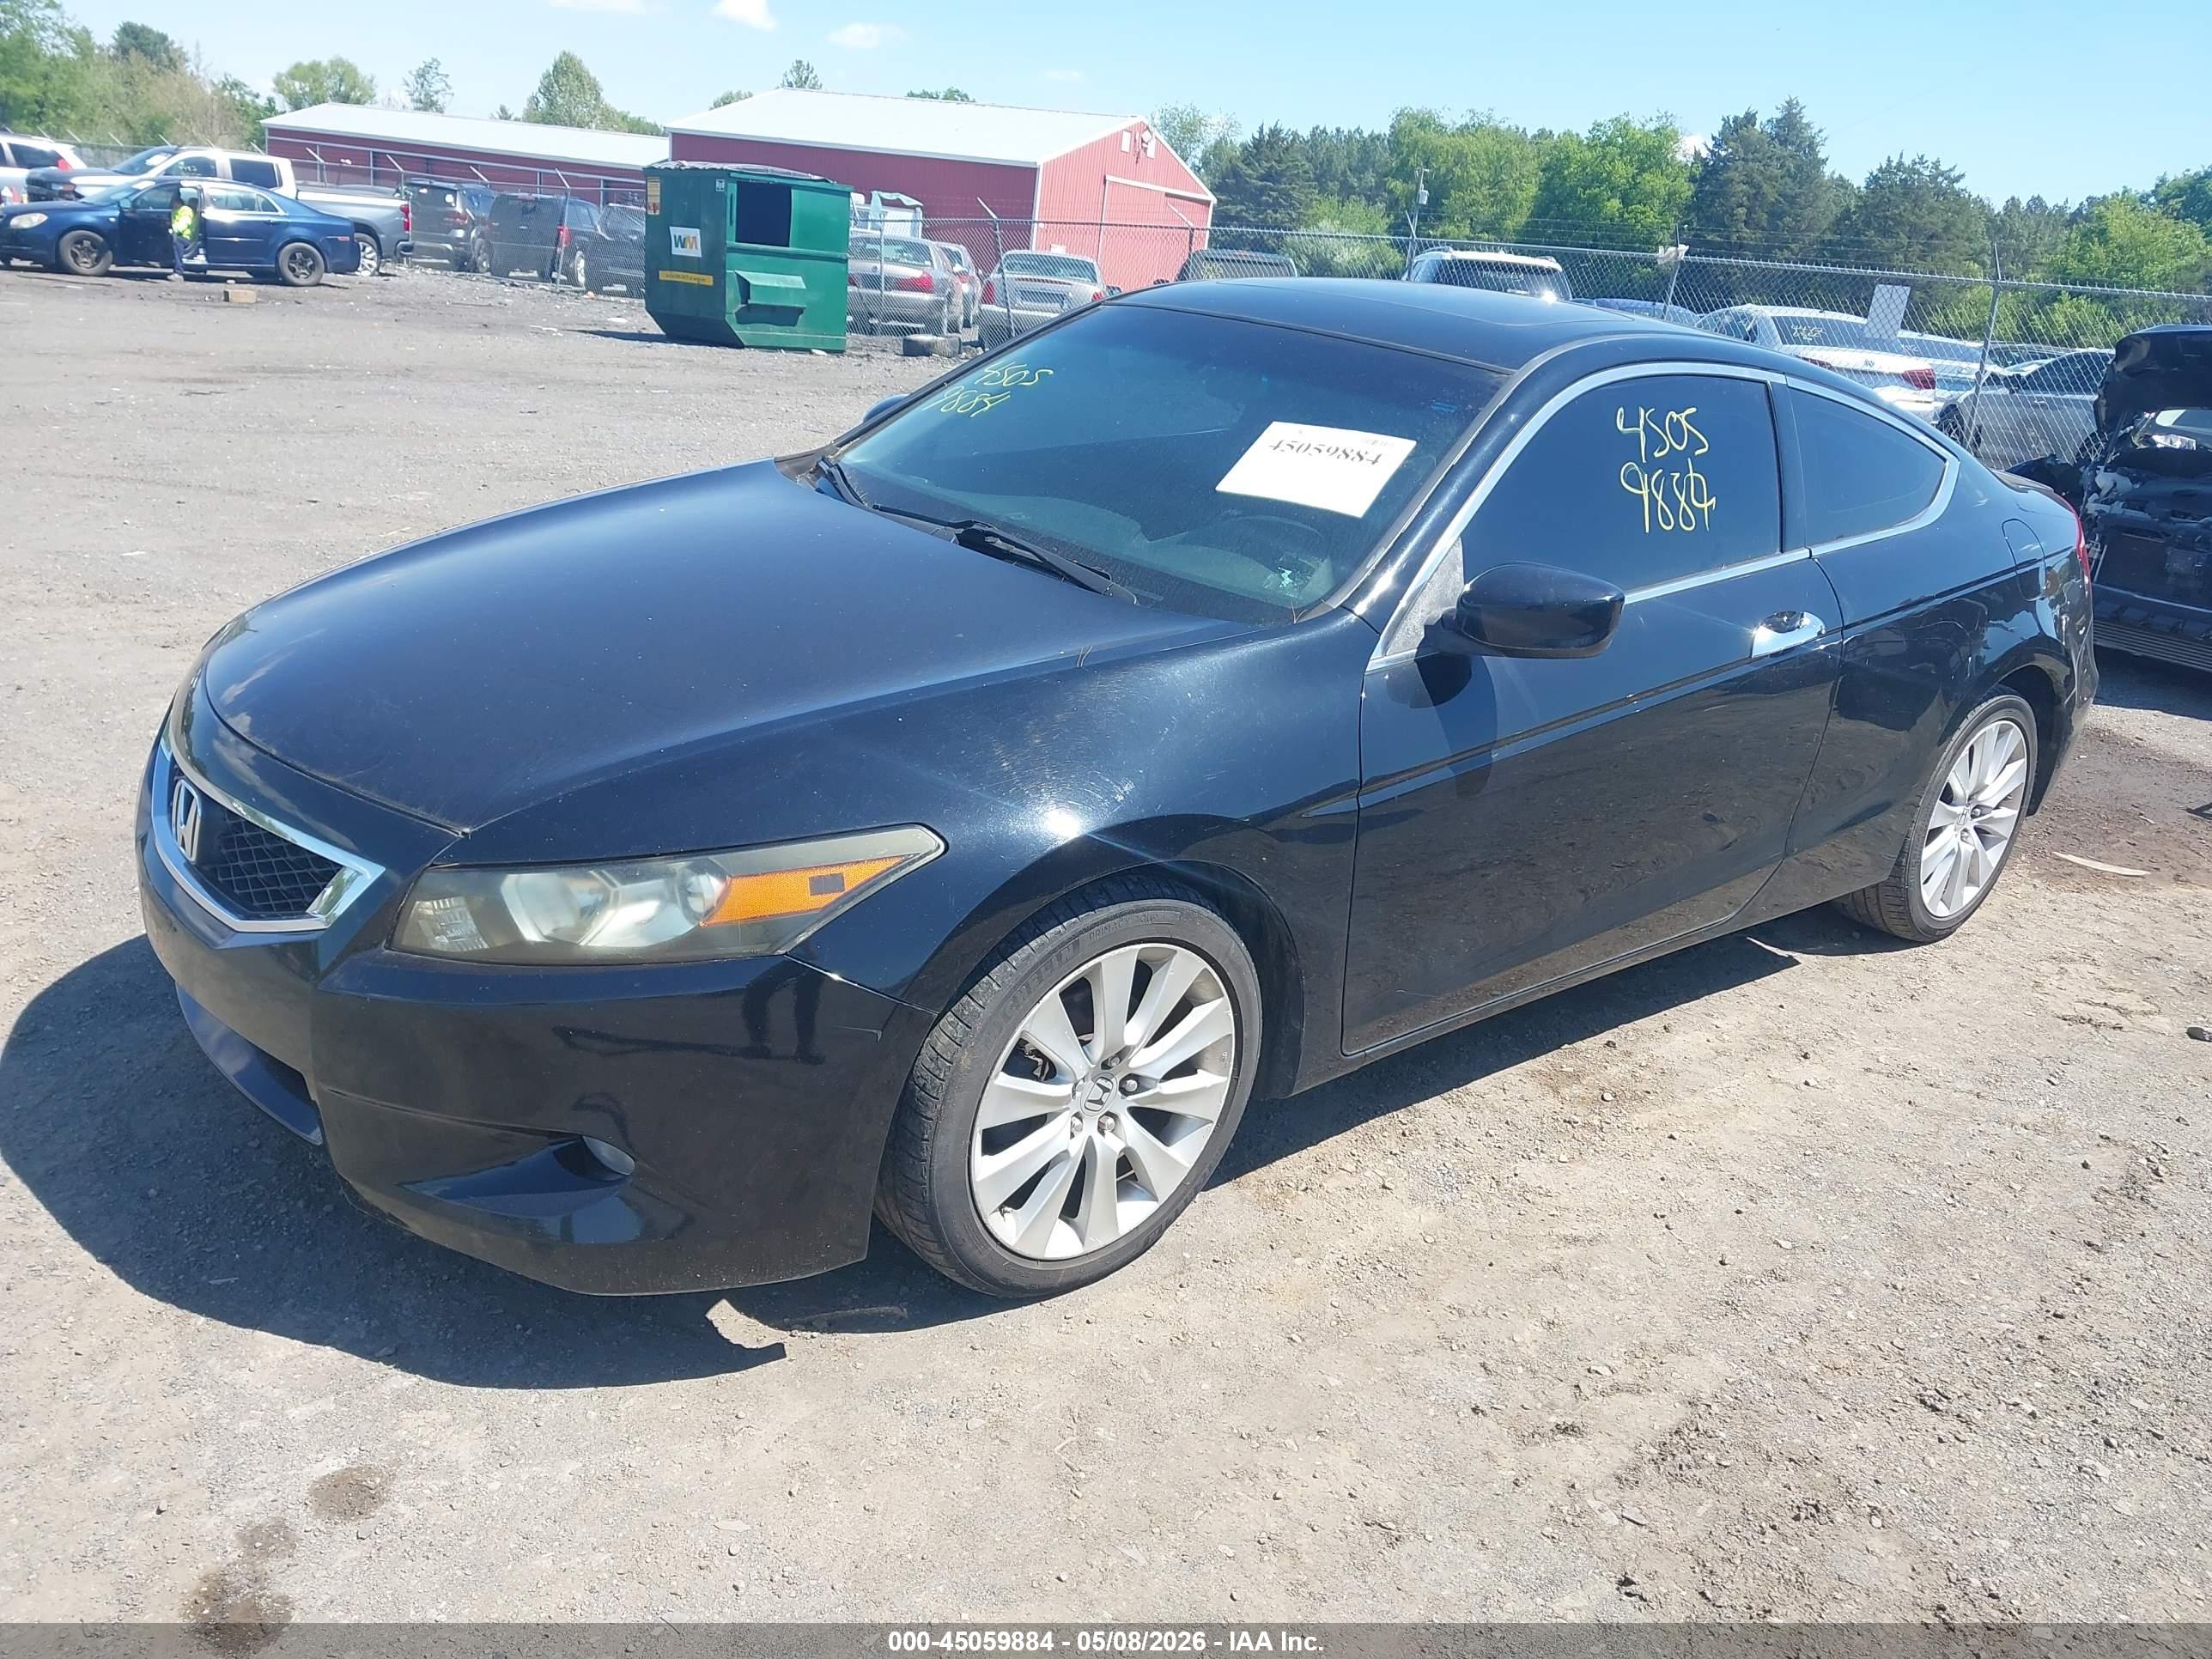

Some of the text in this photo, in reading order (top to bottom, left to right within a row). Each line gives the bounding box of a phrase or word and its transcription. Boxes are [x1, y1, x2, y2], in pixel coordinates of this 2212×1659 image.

[673, 234, 698, 250] WM
[975, 362, 1054, 386] 4505
[922, 386, 1011, 417] 9884
[1616, 406, 1709, 463] 4505
[1269, 439, 1382, 465] 45059884
[1620, 458, 1716, 533] 9884
